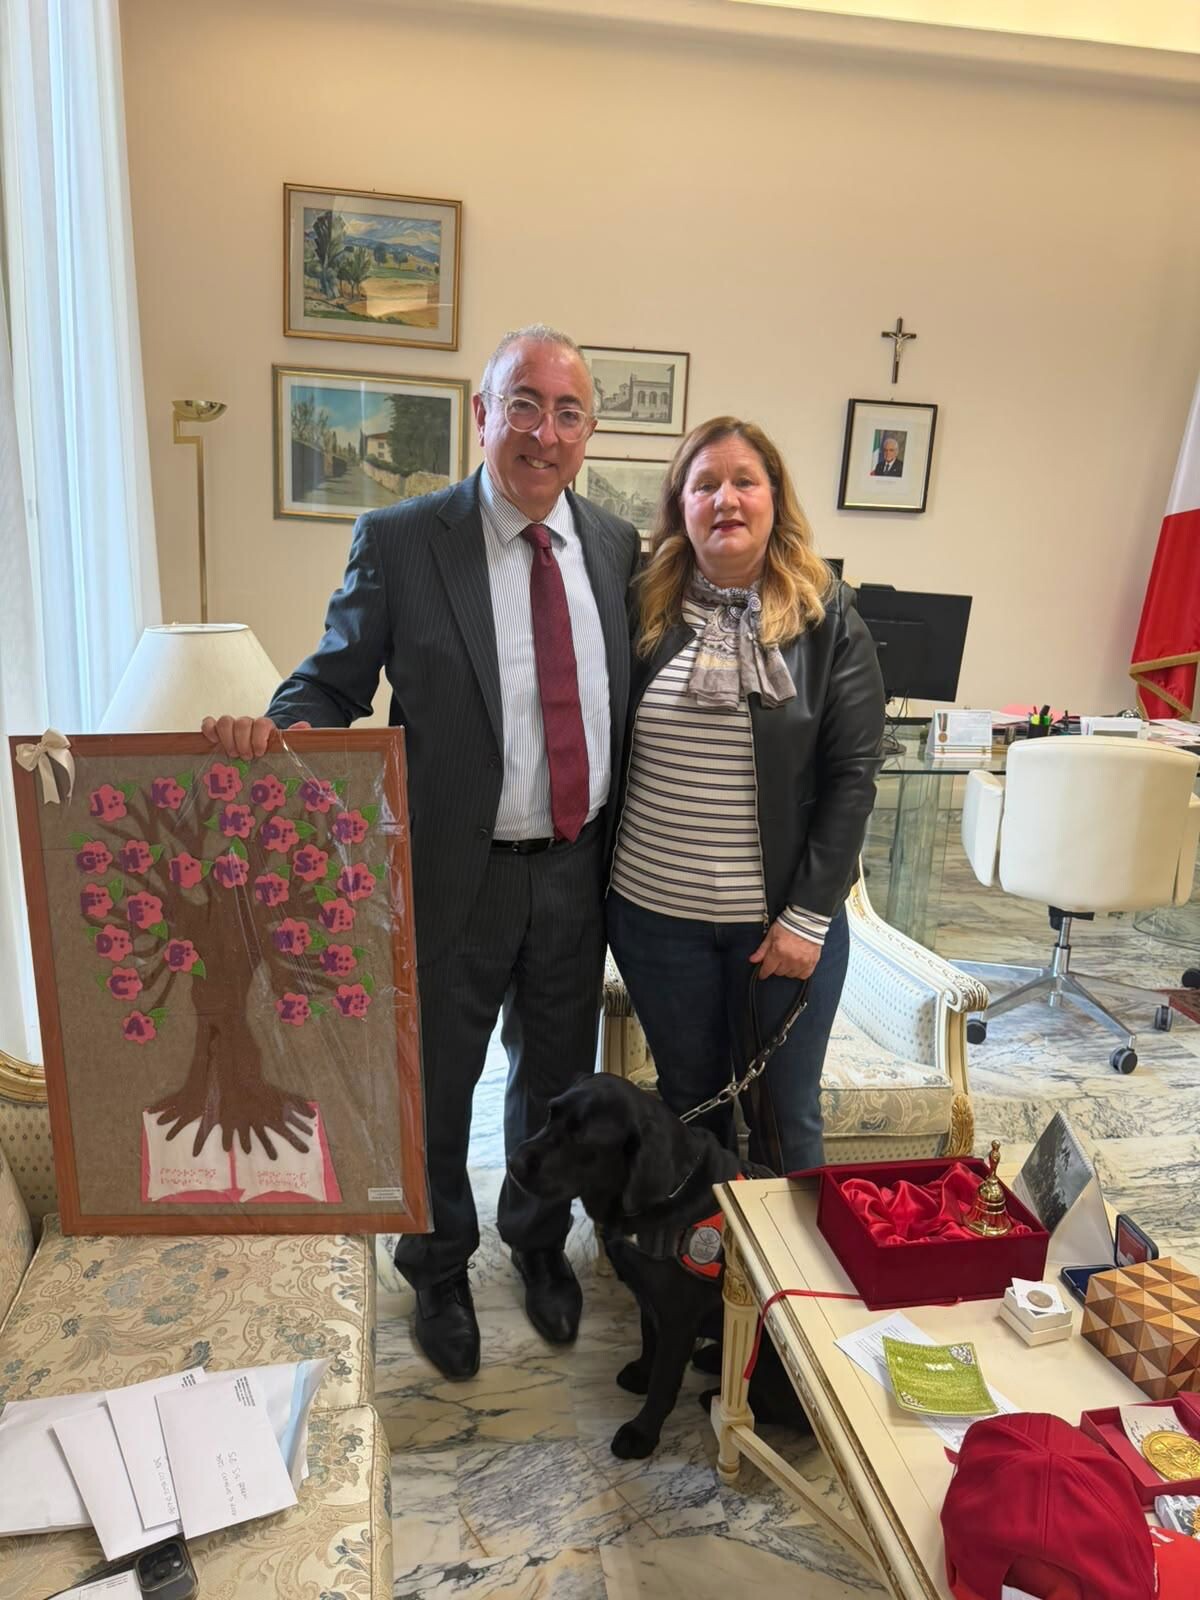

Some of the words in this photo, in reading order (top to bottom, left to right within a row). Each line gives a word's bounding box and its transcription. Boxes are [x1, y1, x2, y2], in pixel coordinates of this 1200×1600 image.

[152, 783, 169, 804] K
[210, 774, 227, 794] L
[251, 784, 270, 804] O
[300, 781, 319, 806] Q
[90, 794, 104, 816] J
[261, 823, 280, 846] P
[335, 818, 350, 840] R
[76, 851, 96, 872] G
[118, 848, 140, 872] H
[295, 852, 312, 873] S
[170, 860, 181, 883] I
[216, 860, 236, 882] N
[256, 882, 274, 904] T
[342, 872, 361, 893] U
[80, 892, 96, 914] F
[128, 899, 144, 922] E
[318, 908, 337, 929] V
[96, 934, 113, 954] D
[169, 944, 186, 966] B
[321, 951, 338, 972] X
[110, 975, 128, 996] C
[281, 1000, 296, 1020] Z
[336, 996, 353, 1014] Y
[124, 1016, 145, 1036] A
